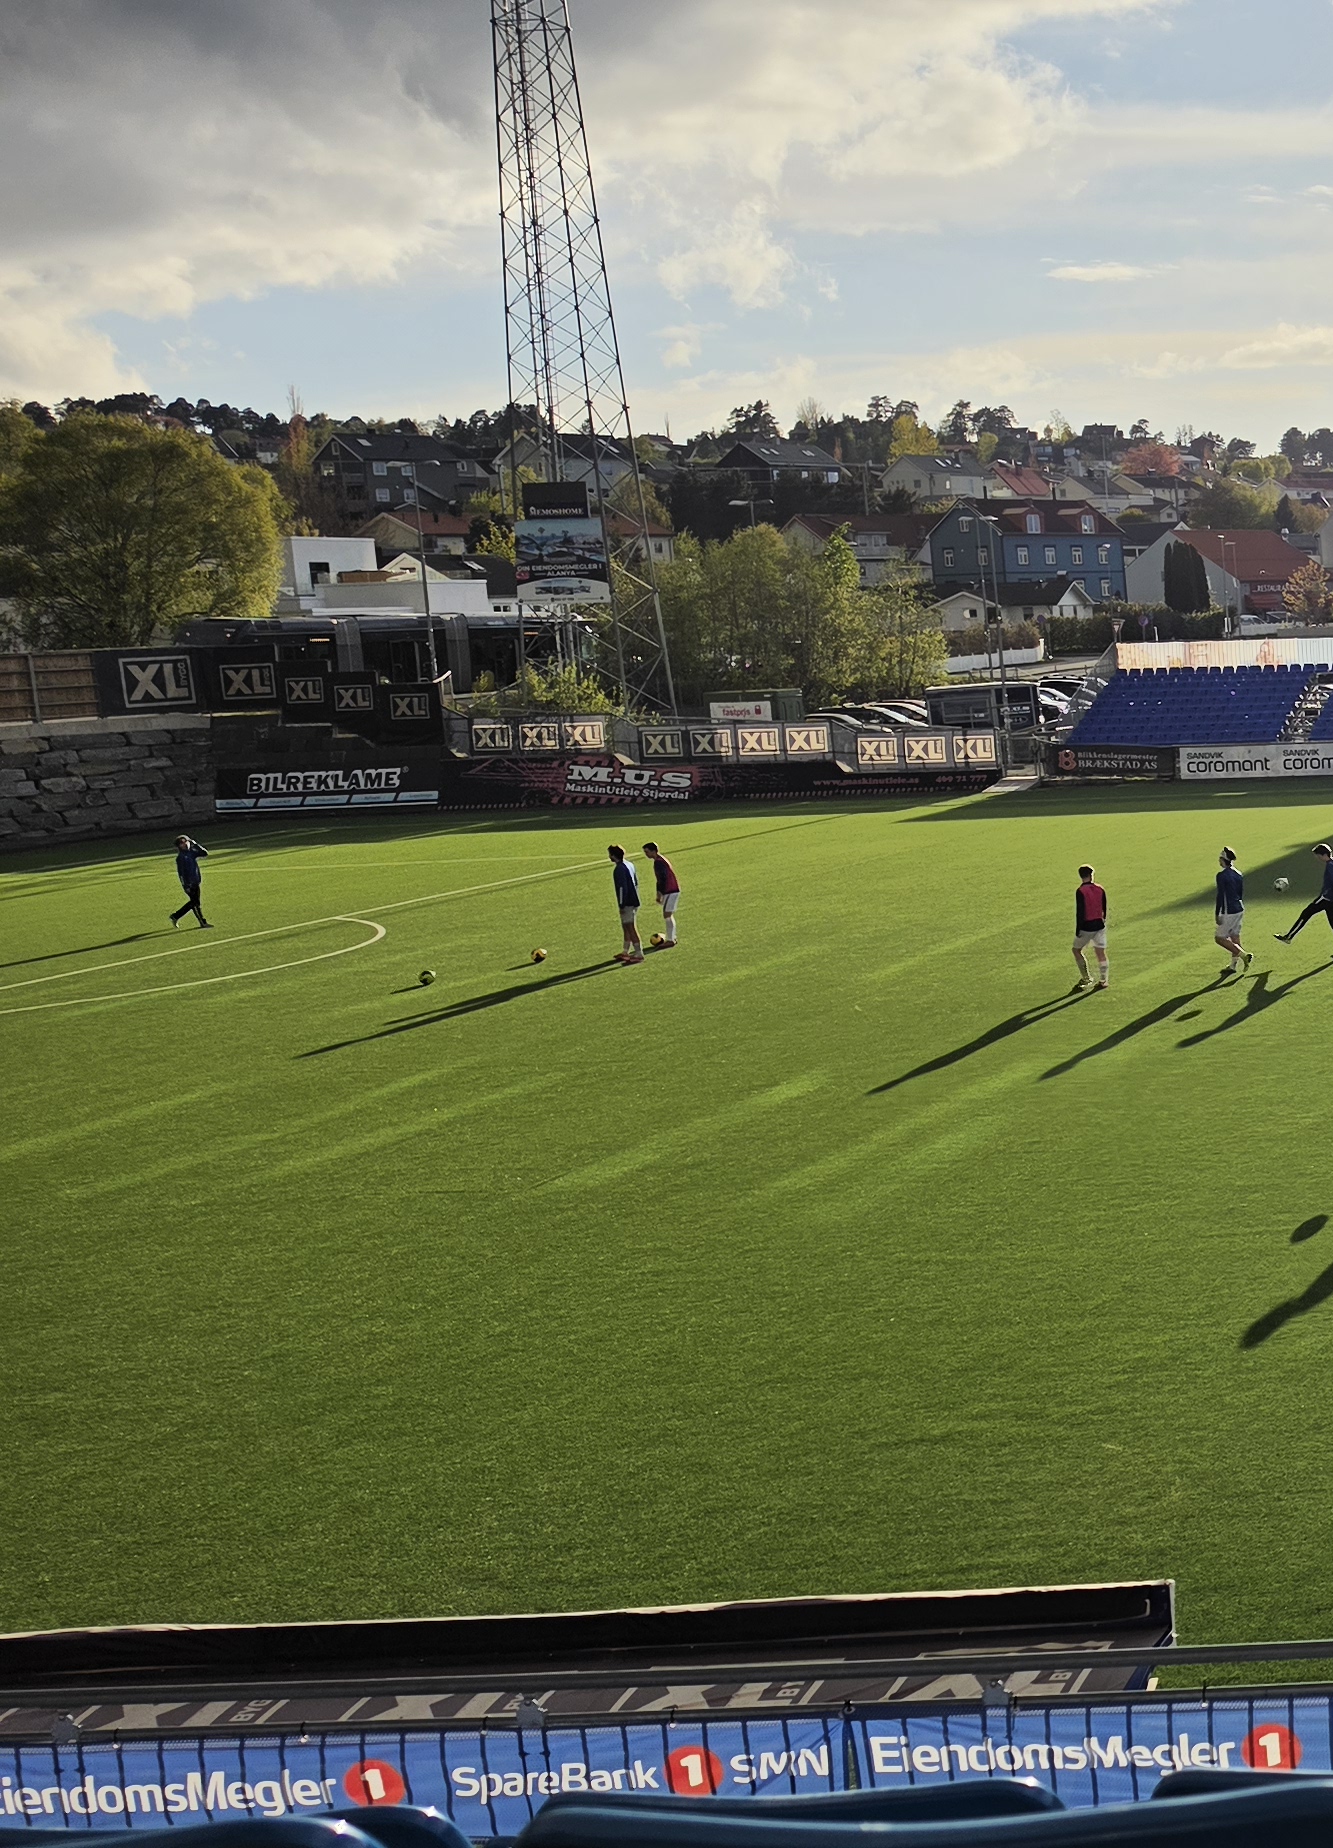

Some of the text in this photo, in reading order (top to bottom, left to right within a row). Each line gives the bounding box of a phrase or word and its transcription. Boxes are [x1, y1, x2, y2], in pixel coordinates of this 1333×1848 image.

[126, 663, 189, 701] XL
[224, 668, 272, 695] XL
[289, 681, 320, 700] XL
[338, 688, 370, 707] XL
[394, 697, 425, 716] XL
[476, 728, 508, 747] XL
[522, 728, 555, 746] XL
[565, 726, 600, 745] XL
[645, 735, 680, 754] XL
[693, 733, 729, 752] XL
[742, 732, 776, 752] XL
[789, 730, 826, 750] XL
[861, 741, 895, 760] XL
[908, 740, 943, 759] XL
[956, 739, 992, 758] XL
[1186, 752, 1224, 760] SANDVIK
[1282, 748, 1319, 756] SANDVIK
[1078, 760, 1158, 769] BRÆKSTAD AS
[1186, 757, 1270, 773] coromant
[247, 767, 401, 794] BILREKLAME
[567, 765, 691, 788] M.U.S
[867, 1731, 1283, 1773] EiendomsMegler 1
[452, 1745, 829, 1803] SpareBank 1 SMN
[361, 1768, 386, 1800] 1
